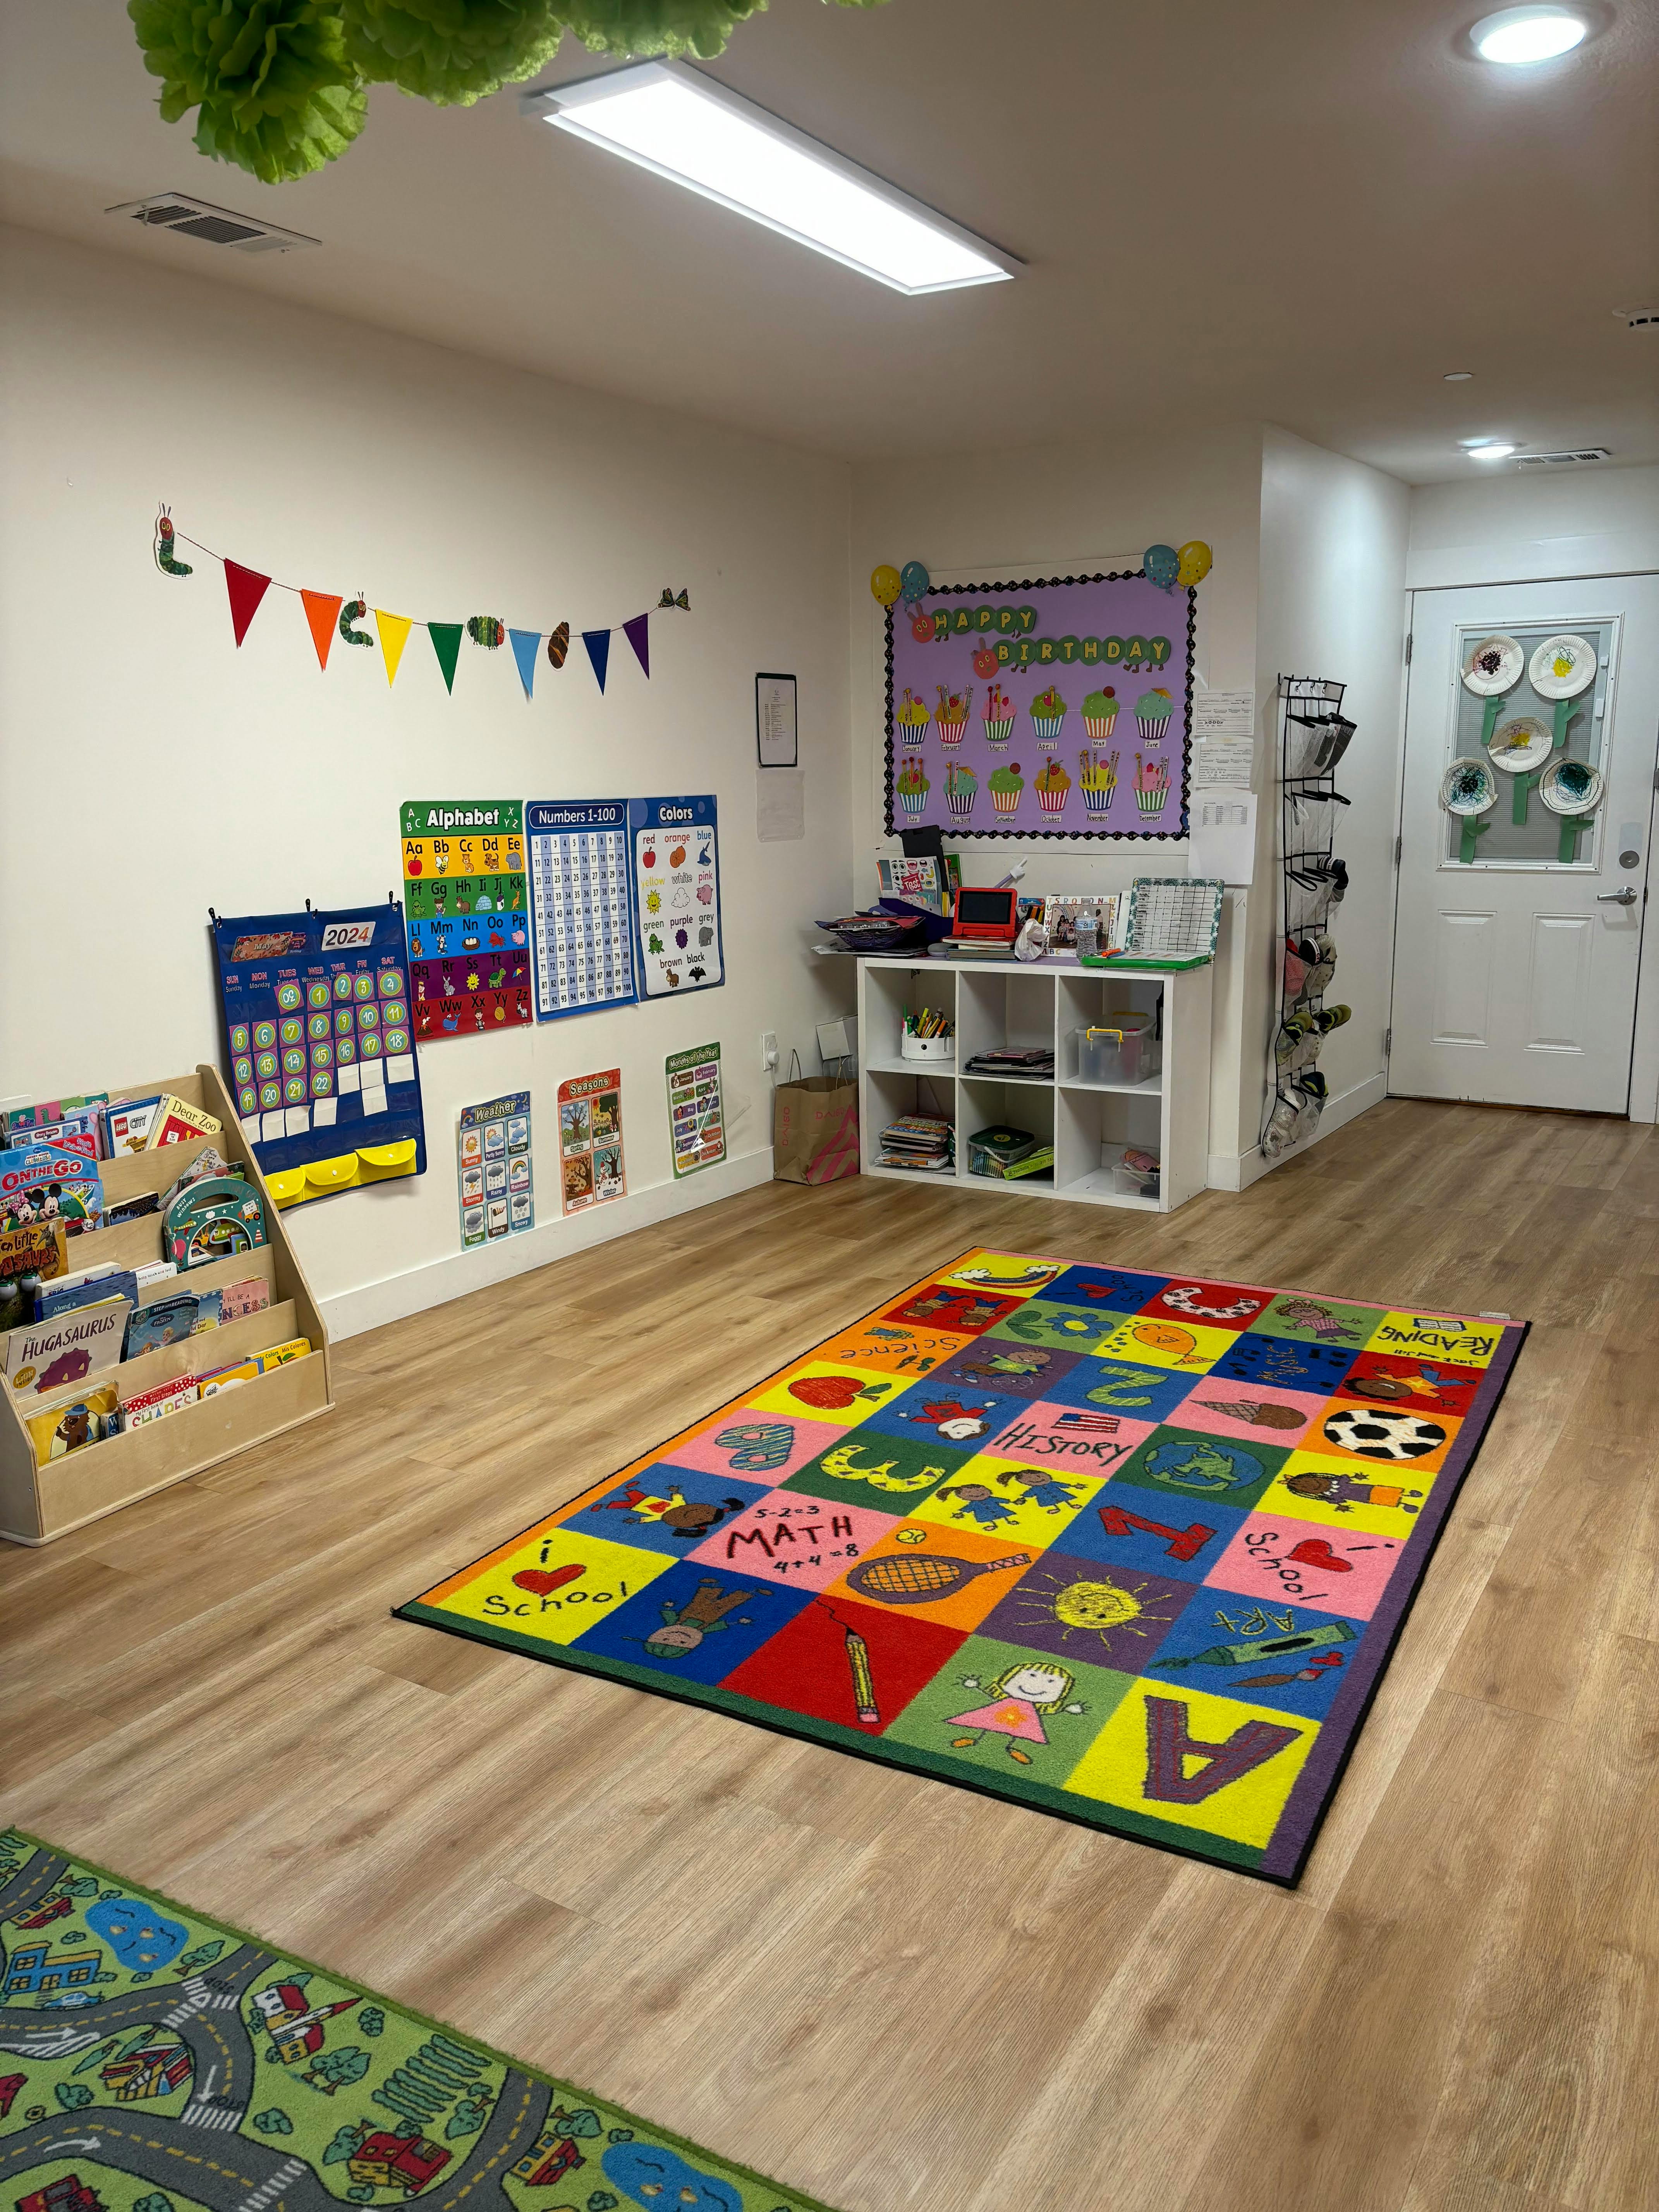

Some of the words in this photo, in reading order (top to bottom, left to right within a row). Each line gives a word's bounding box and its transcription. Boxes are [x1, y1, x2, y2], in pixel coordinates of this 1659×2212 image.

[935, 611, 1032, 630] HAPPY
[999, 642, 1165, 661] BIRTHDAY
[426, 808, 499, 830] Alphabet
[539, 809, 585, 824] Numbers
[588, 807, 616, 821] 1-100
[659, 806, 693, 821] Colors
[406, 841, 422, 854] Aa
[434, 839, 449, 853] Bb
[459, 839, 473, 852] Cc
[483, 837, 499, 851] Dd
[508, 838, 520, 850] Ee
[643, 834, 655, 844] red
[665, 834, 690, 844] orange
[697, 831, 711, 840] blue
[411, 882, 422, 896] Ff
[431, 881, 447, 898] Gg
[456, 879, 471, 893] Hh
[510, 876, 523, 889] Kk
[641, 877, 665, 890] yellow
[672, 872, 692, 884] white
[699, 871, 713, 884] pink
[904, 878, 920, 891] Test
[430, 921, 453, 934] Mm
[463, 918, 478, 931] Nn
[487, 916, 503, 929] Oo
[512, 914, 526, 929] Pp
[644, 921, 664, 933] green
[670, 915, 693, 929] purple
[699, 914, 714, 924] grey
[326, 927, 369, 946] 2024
[331, 963, 345, 971] THUR
[412, 963, 430, 979] Qq
[442, 960, 455, 973] Rr
[466, 957, 479, 970] Ss
[490, 955, 502, 967] Tt
[513, 951, 527, 963] Uu
[659, 958, 682, 969] brown
[687, 952, 705, 963] black
[226, 975, 239, 984] SUN
[252, 972, 267, 981] MON
[278, 969, 296, 977] TUES
[308, 967, 324, 975] WED
[415, 1004, 430, 1017] Vv
[439, 999, 462, 1013] Ww
[471, 995, 485, 1007] Xx
[493, 992, 508, 1007] Yy
[516, 989, 528, 1001] Zz
[363, 1011, 374, 1022] 10
[389, 1007, 399, 1018] 11
[239, 1064, 247, 1077] 12
[261, 1060, 271, 1072] 13
[288, 1055, 300, 1067] 14
[316, 1050, 326, 1062] 15
[342, 1045, 350, 1056] 16
[365, 1039, 376, 1051] 17
[390, 1034, 402, 1047] 18
[670, 1056, 689, 1069] Months
[690, 1053, 696, 1063] of
[697, 1051, 705, 1061] the
[706, 1048, 717, 1057] Year
[244, 1094, 252, 1107] 19
[266, 1089, 276, 1102] 20
[290, 1084, 301, 1096] 21
[316, 1077, 327, 1089] 22
[570, 1077, 609, 1096] Seasons
[171, 1100, 198, 1121] Dear
[199, 1115, 216, 1132] Zoo
[476, 1101, 515, 1121] Weather
[116, 1123, 127, 1131] LEGO
[130, 1115, 146, 1128] CITY
[2, 1170, 31, 1190] ON
[32, 1166, 53, 1178] THE
[54, 1159, 82, 1176] GO
[603, 1188, 617, 1196] Winter
[176, 1197, 187, 1211] BUSY
[177, 1197, 195, 1218] WINDOWS
[15, 1231, 38, 1250] Little
[1097, 1273, 1144, 1302] School
[53, 1304, 70, 1312] Along
[171, 1298, 192, 1307] READING
[154, 1317, 171, 1326] FROZEN
[198, 1322, 206, 1331] Day
[22, 1314, 116, 1362] HUGASAURUS
[290, 1341, 306, 1350] Colores
[1377, 1326, 1494, 1356] READING
[841, 1338, 960, 1358] Science
[161, 1391, 172, 1399] Steps
[1087, 1365, 1168, 1407] 2
[993, 1422, 1133, 1467] HISTORY
[821, 1443, 945, 1493] 3
[727, 1516, 852, 1558] MATH
[1097, 1505, 1217, 1562] 1
[1245, 1531, 1328, 1601] School
[483, 1581, 627, 1615] School
[1142, 1695, 1304, 1805] A
